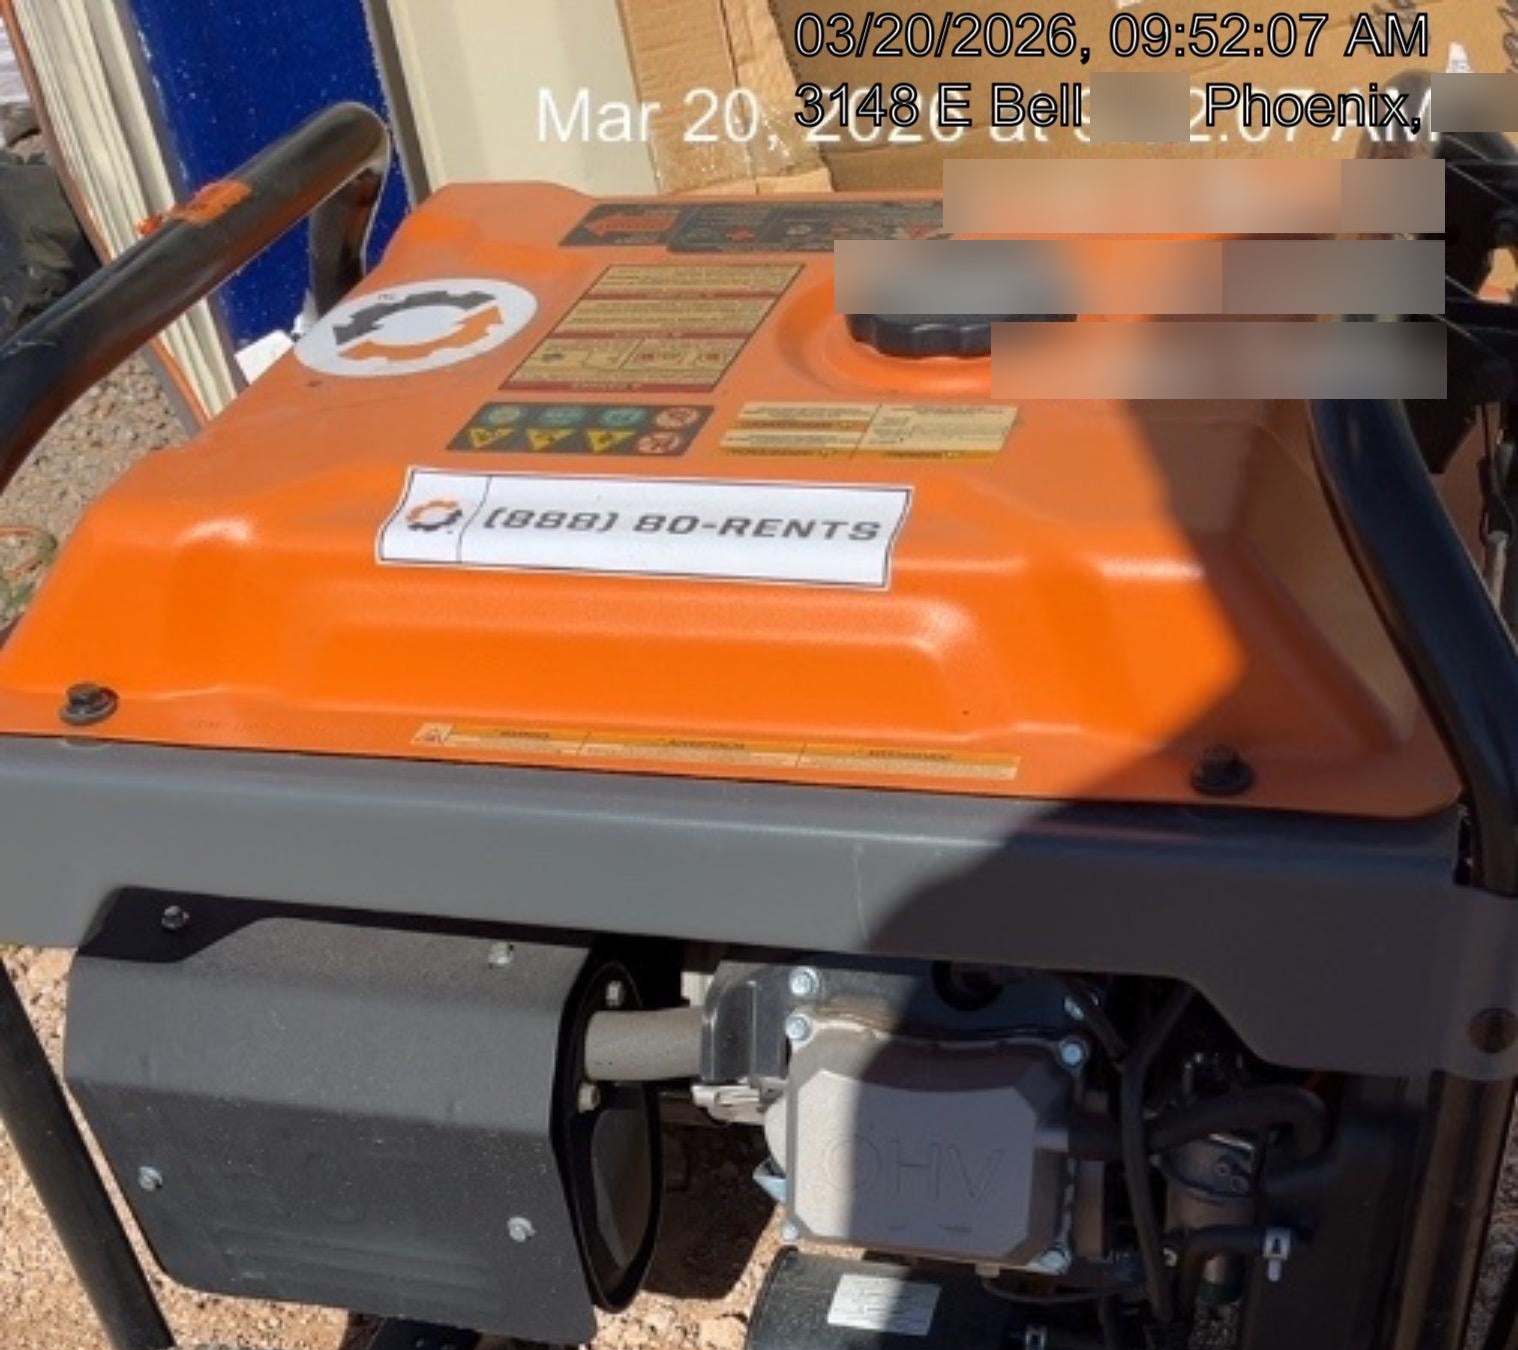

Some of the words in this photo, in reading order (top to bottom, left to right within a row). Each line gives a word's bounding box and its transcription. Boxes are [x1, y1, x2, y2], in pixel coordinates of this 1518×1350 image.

[482, 507, 617, 535] (888)
[632, 513, 884, 545] 80-RENTS
[826, 1132, 1006, 1201] OHV
